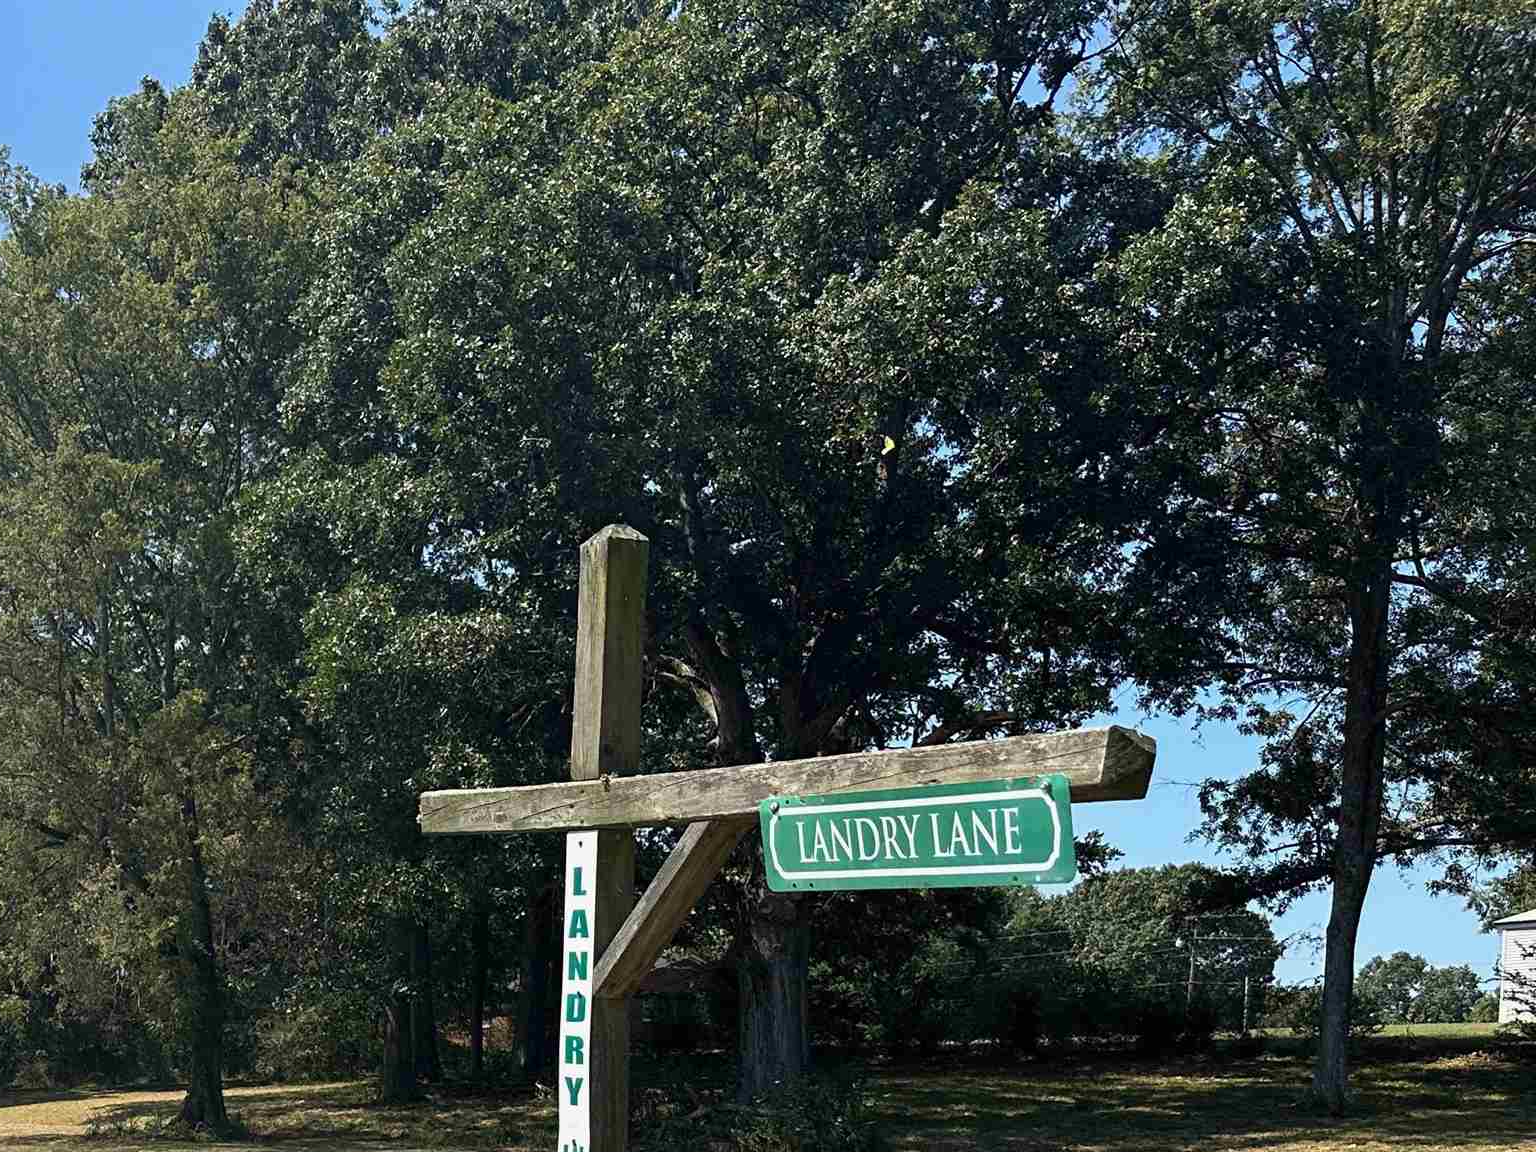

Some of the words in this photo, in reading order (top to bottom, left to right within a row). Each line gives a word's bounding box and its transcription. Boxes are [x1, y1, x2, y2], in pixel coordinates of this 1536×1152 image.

[796, 813, 921, 863] LANDRY
[929, 807, 1022, 858] LANE
[564, 866, 589, 1106] LANDRY
